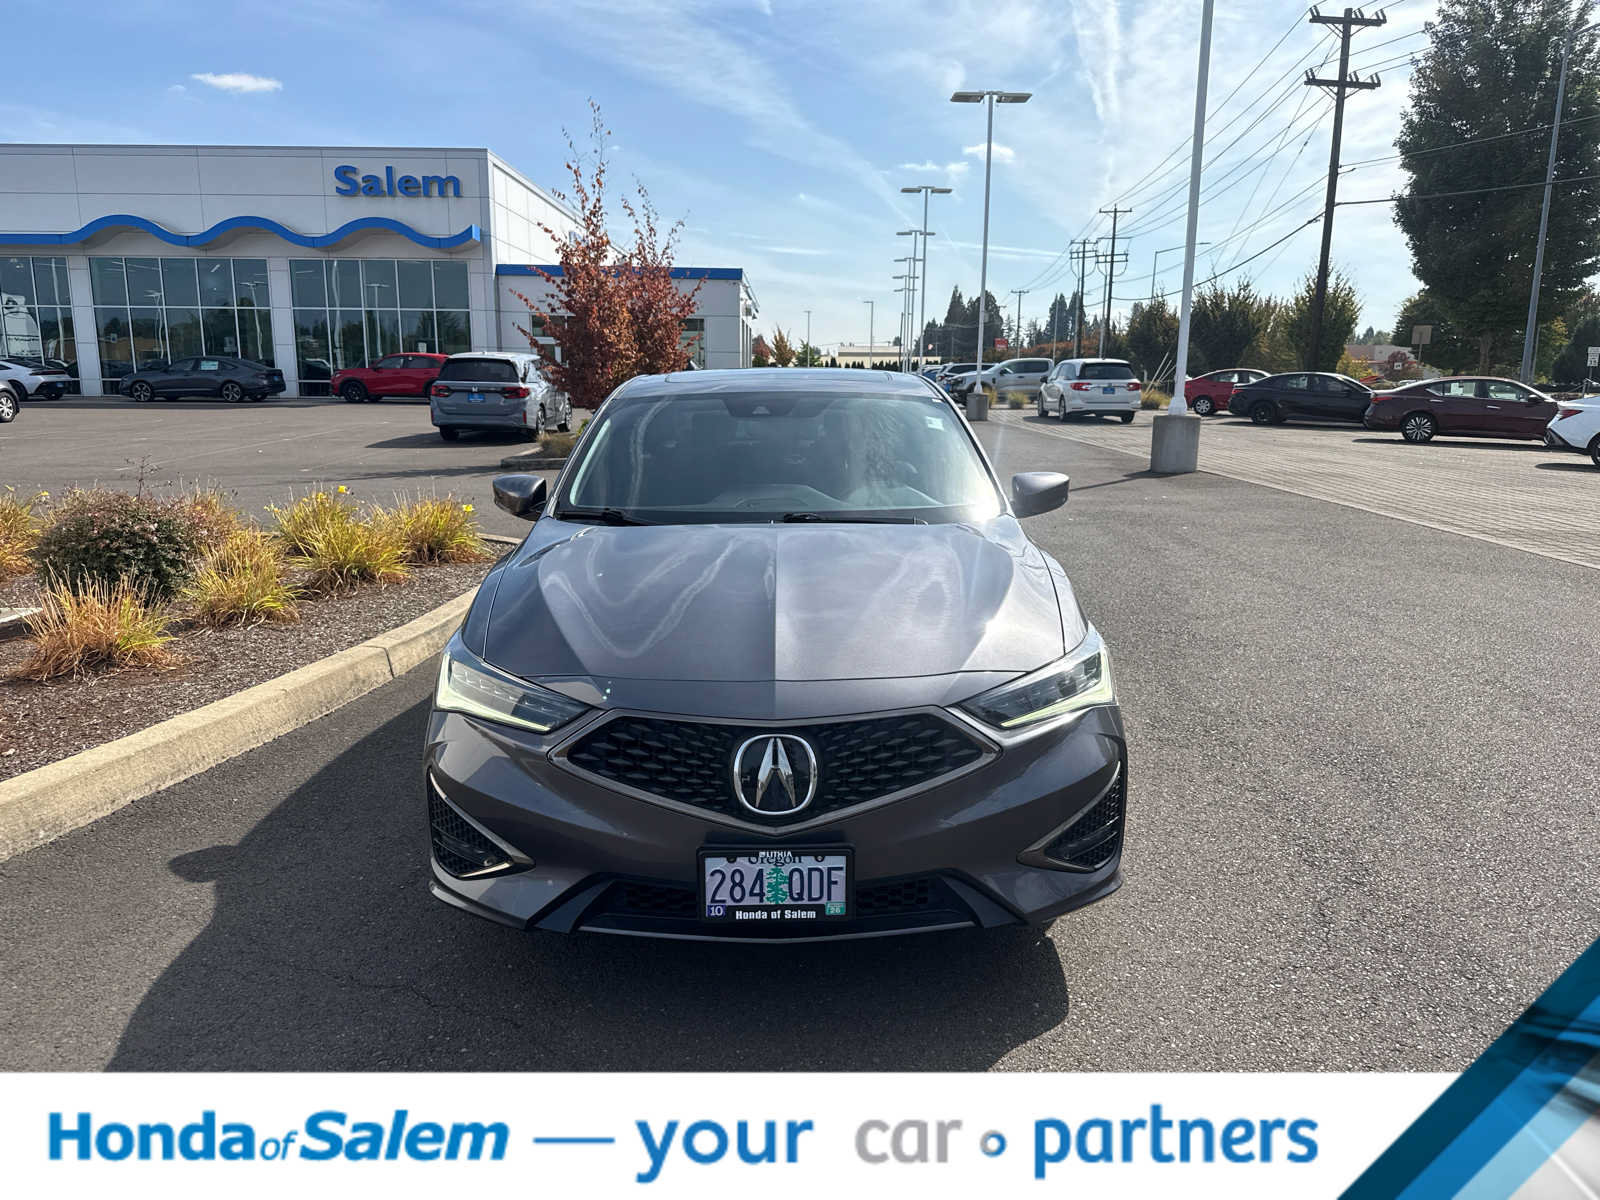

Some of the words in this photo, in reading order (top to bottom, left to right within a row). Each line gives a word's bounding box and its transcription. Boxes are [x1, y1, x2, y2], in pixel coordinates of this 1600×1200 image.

[334, 165, 463, 198] Salem
[709, 868, 766, 904] 284
[787, 866, 844, 902] QDF
[710, 905, 723, 916] 10
[735, 910, 768, 920] Honda
[770, 910, 781, 919] of
[784, 909, 817, 919] Salem
